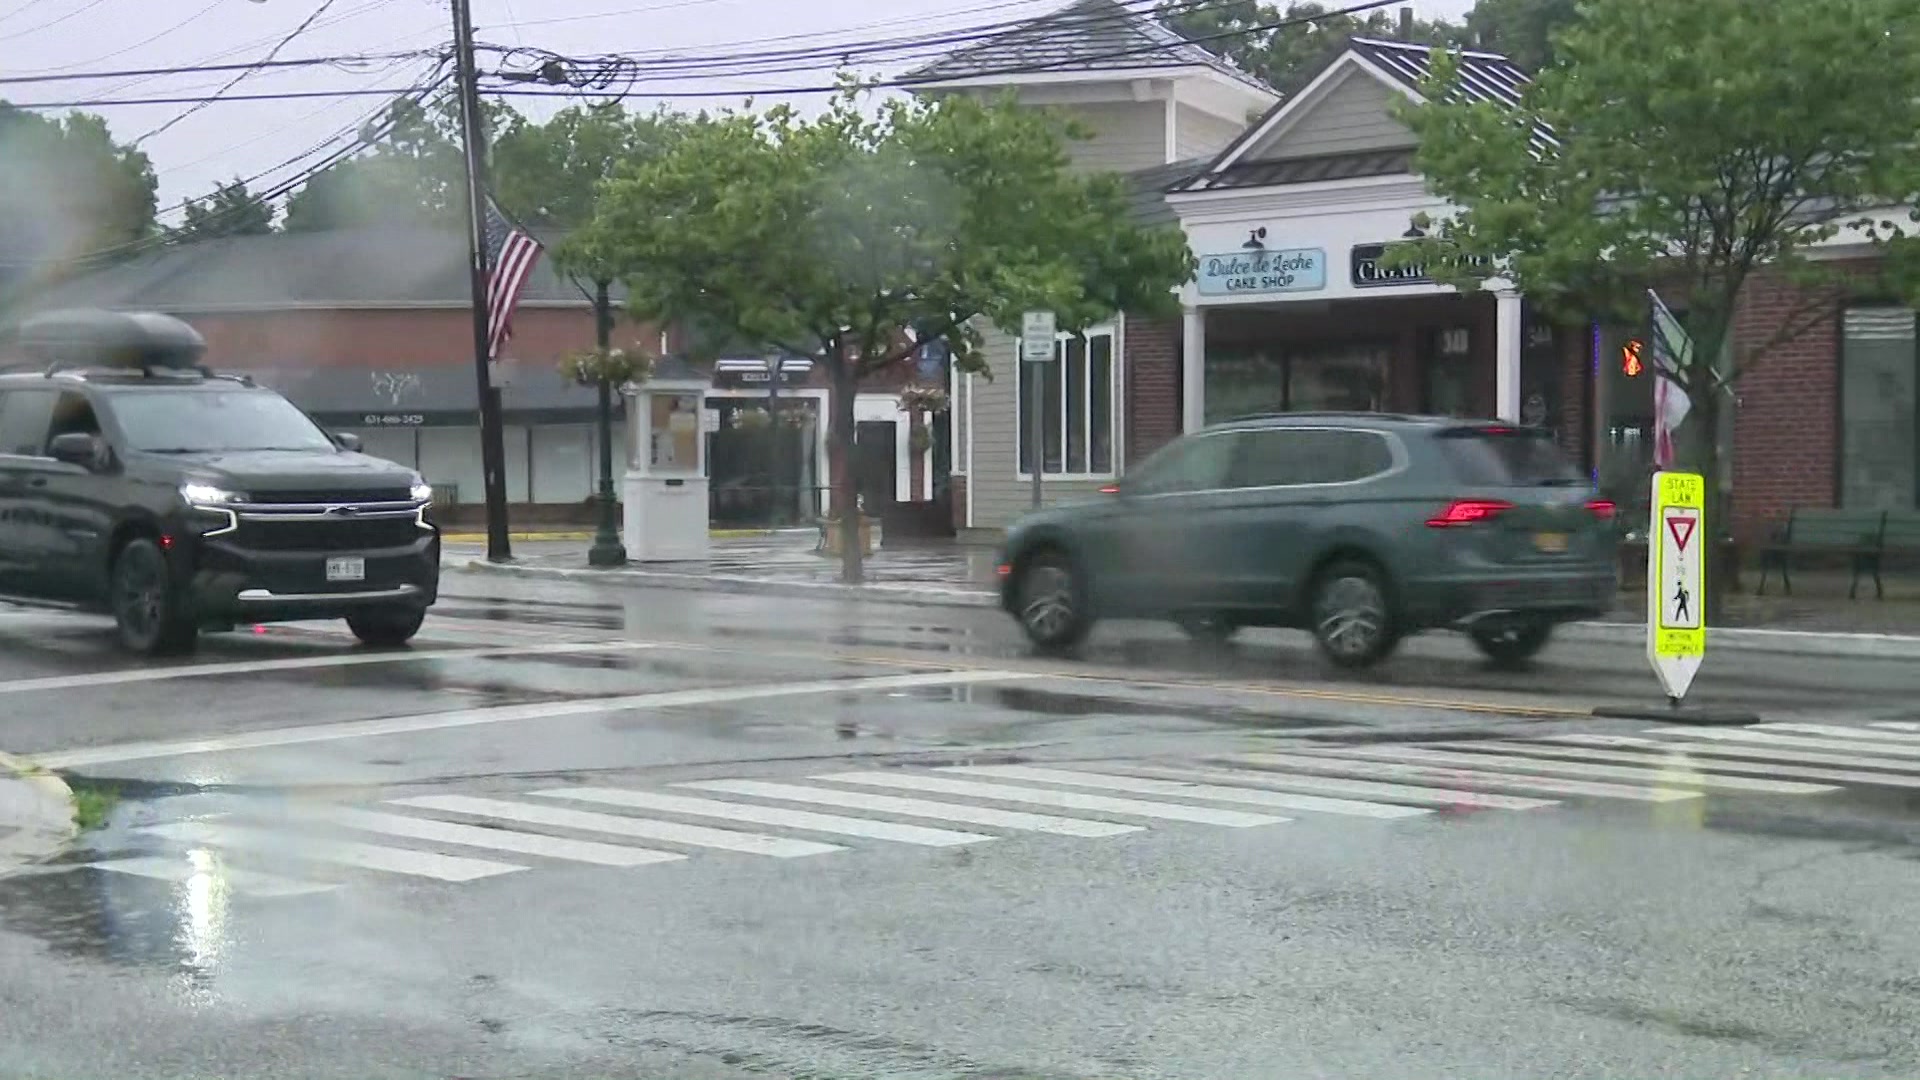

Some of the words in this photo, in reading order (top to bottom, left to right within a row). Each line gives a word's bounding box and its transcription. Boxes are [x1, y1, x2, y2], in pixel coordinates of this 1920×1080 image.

[1207, 257, 1251, 277] Dulce
[1252, 254, 1270, 273] de
[1272, 253, 1313, 275] Leche
[1226, 276, 1257, 290] CAKE
[1261, 274, 1294, 289] SHOP
[1665, 478, 1697, 491] STATE
[1671, 491, 1693, 504] LAW
